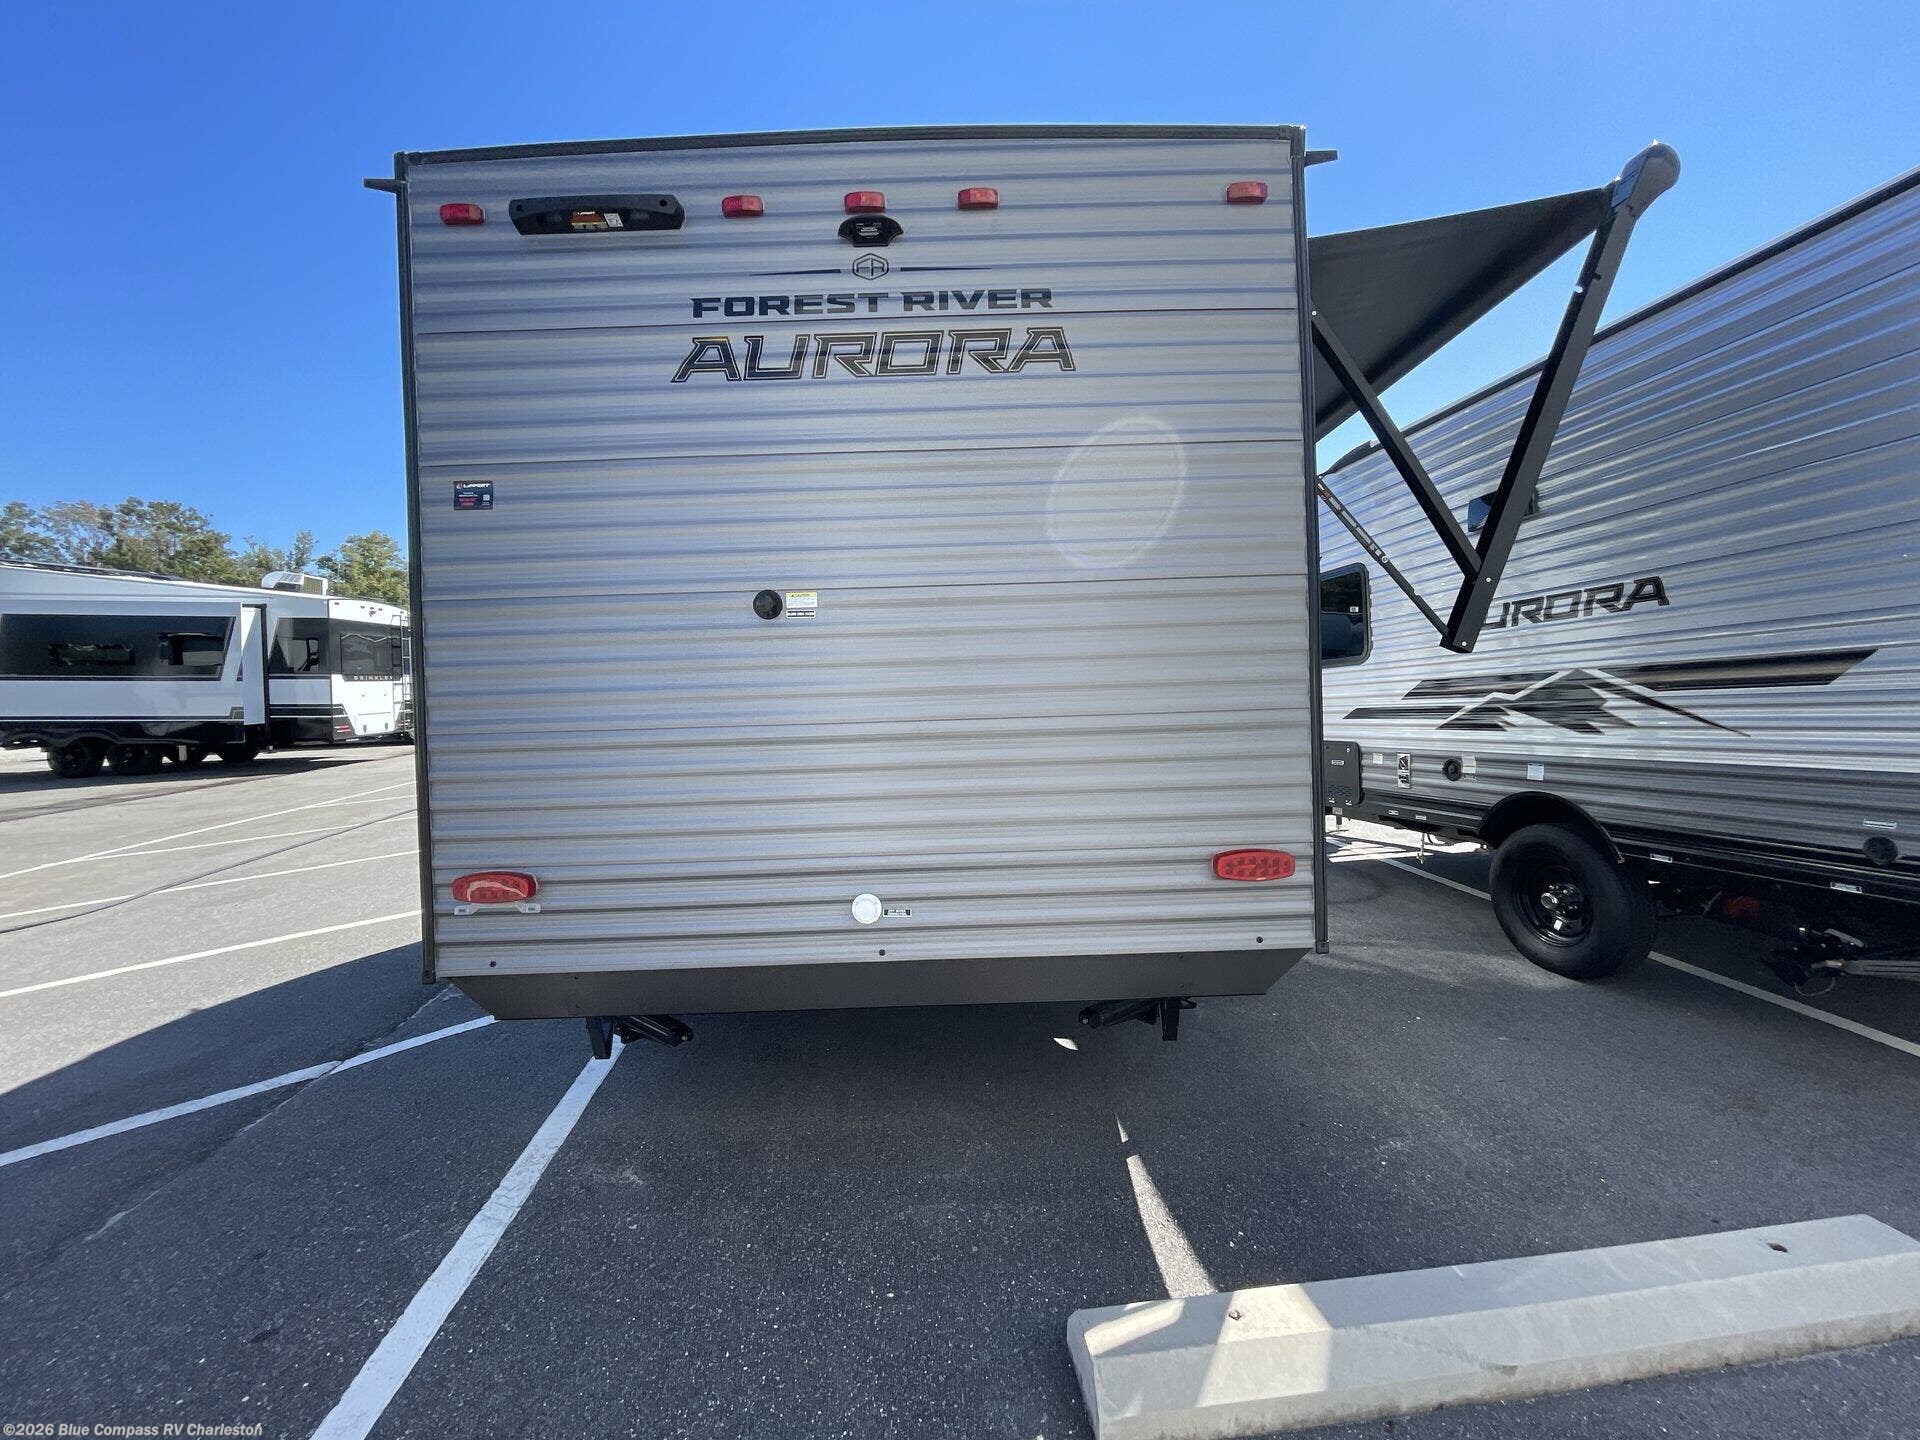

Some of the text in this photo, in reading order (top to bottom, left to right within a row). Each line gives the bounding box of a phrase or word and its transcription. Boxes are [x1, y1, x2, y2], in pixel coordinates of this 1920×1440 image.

[691, 289, 1053, 318] FOREST RIVER
[671, 328, 1076, 382] AURORA
[1483, 576, 1669, 629] URORA
